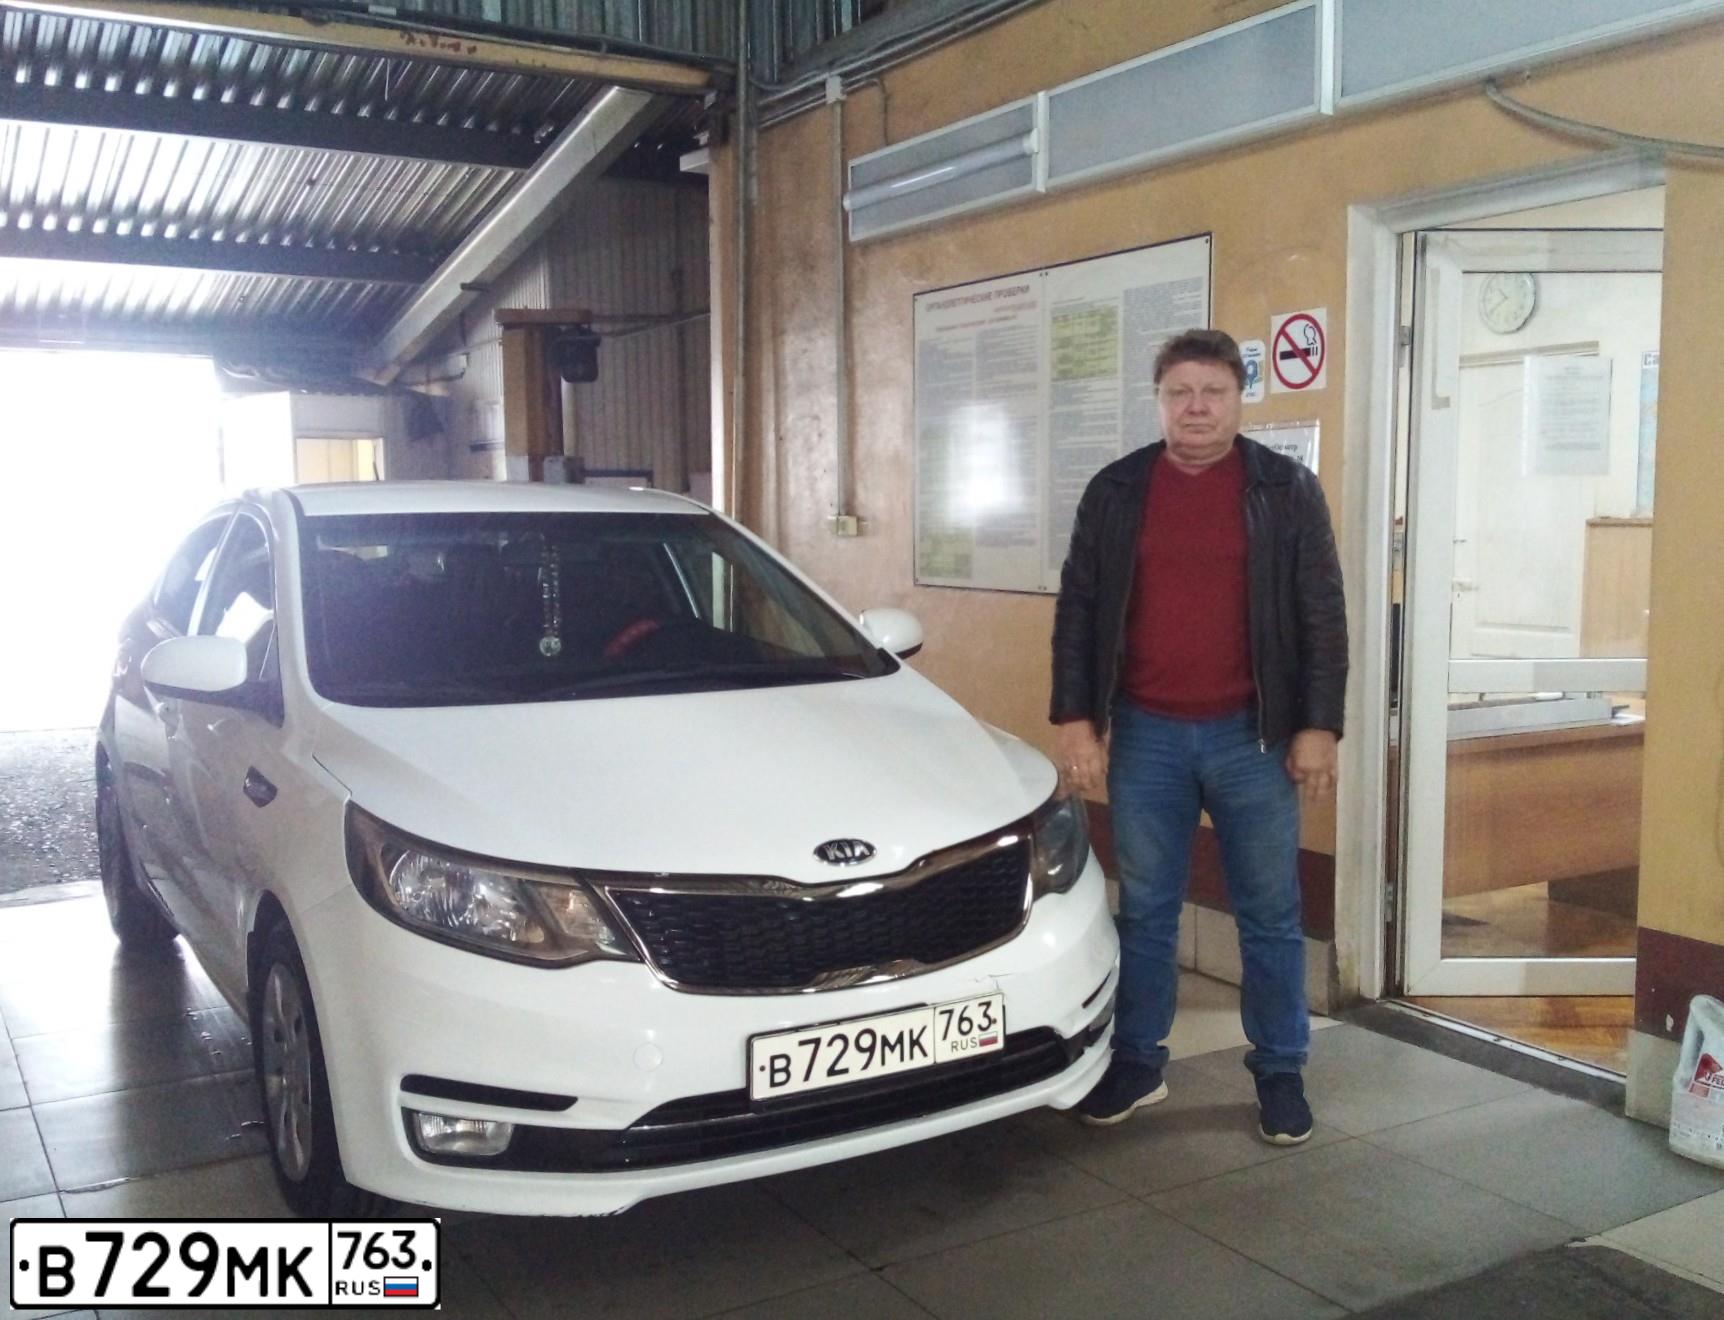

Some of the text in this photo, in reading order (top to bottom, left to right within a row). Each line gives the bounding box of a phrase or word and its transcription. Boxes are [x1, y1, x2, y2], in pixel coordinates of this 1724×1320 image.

[824, 840, 870, 860] KIA
[769, 1001, 992, 1088] В729МК 763
[950, 1037, 978, 1053] RUS
